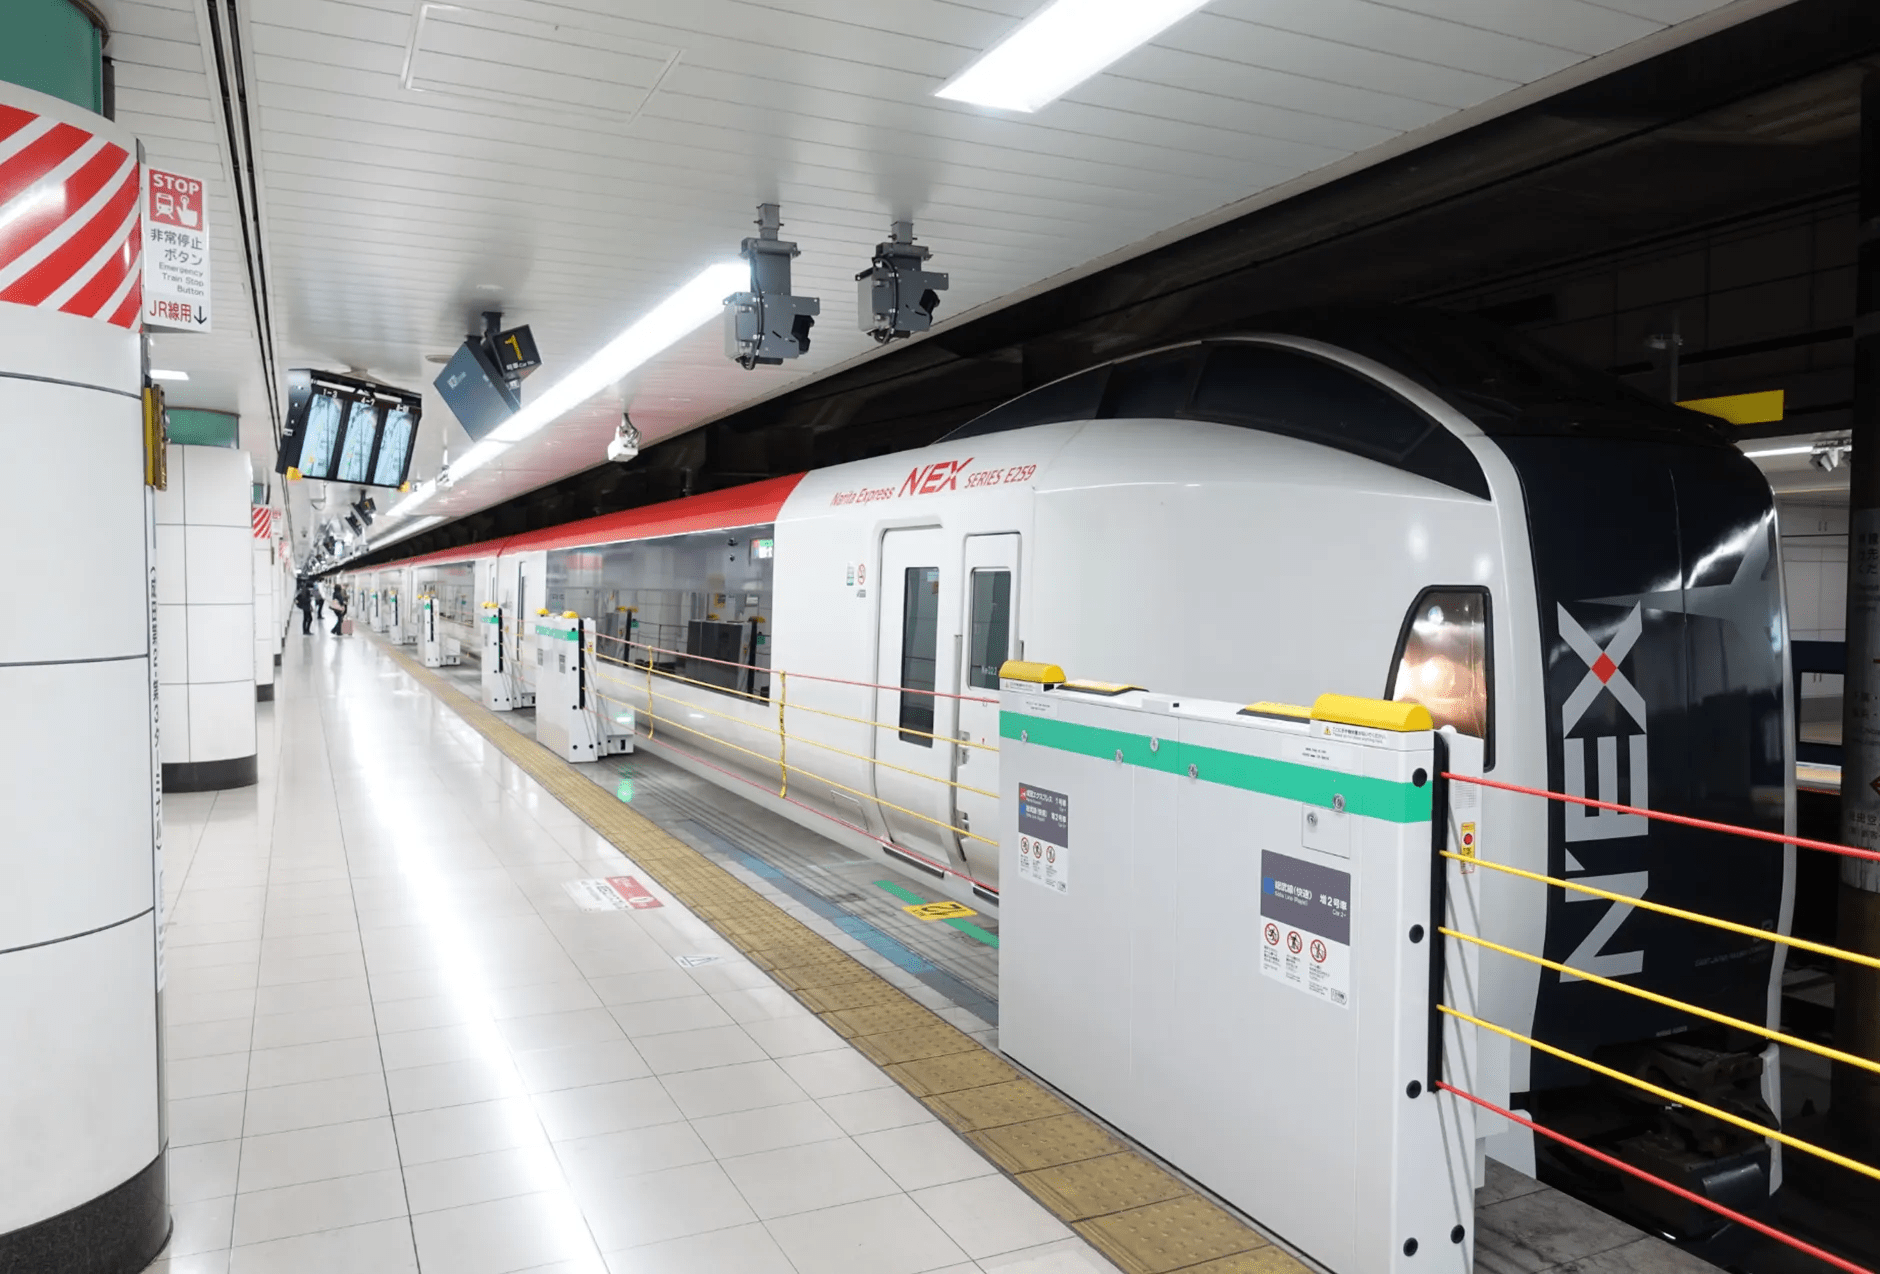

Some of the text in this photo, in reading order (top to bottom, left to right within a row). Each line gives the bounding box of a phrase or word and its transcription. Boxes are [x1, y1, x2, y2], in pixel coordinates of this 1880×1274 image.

[152, 173, 200, 195] STOP
[150, 228, 202, 250] 非常停止
[164, 248, 202, 266] ボタン
[158, 262, 204, 278] Emergency
[162, 272, 204, 288] Train Stop
[176, 284, 204, 296] Button
[149, 300, 192, 324] JR線用
[504, 334, 523, 361] 1
[830, 491, 857, 508] Narita
[856, 486, 896, 506] Express
[964, 468, 1005, 489] SERIES
[1004, 464, 1037, 484] E259
